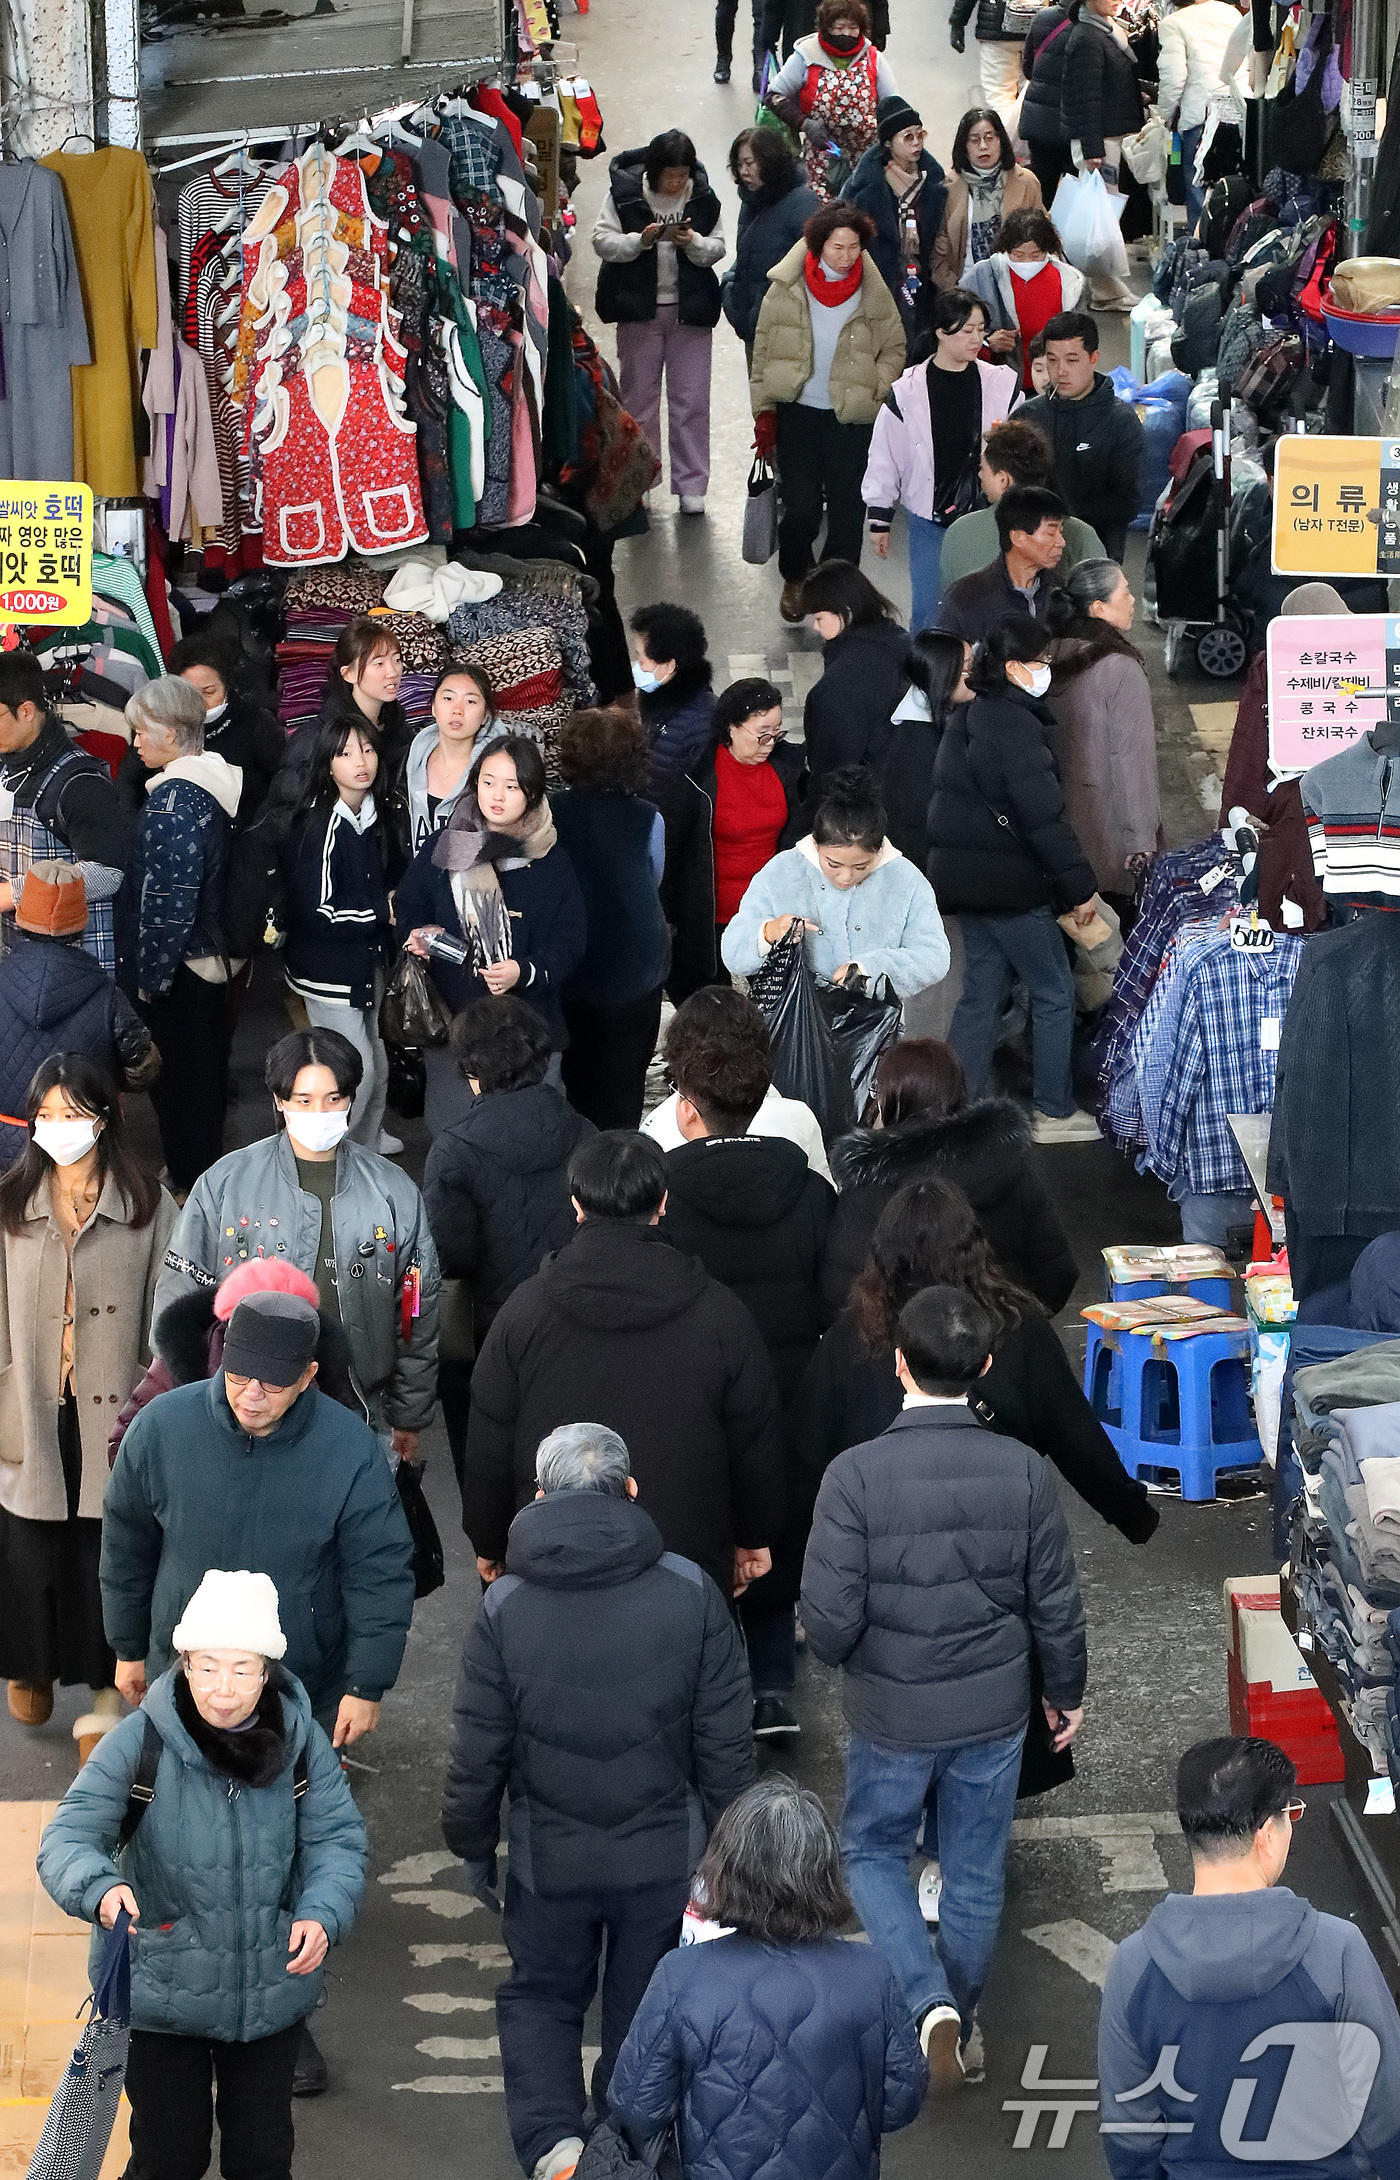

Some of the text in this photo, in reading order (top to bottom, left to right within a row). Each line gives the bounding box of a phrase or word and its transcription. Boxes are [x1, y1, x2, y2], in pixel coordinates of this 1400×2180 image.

[43, 494, 83, 522] 호떡
[1293, 517, 1365, 533] (남자 T전문)
[19, 526, 48, 548] 영양
[54, 527, 83, 549] 많은
[0, 552, 81, 586] 앗 호떡
[2, 593, 60, 612] 1,000원
[1299, 651, 1358, 665] 손칼국수
[1301, 726, 1359, 740] 잔치국수
